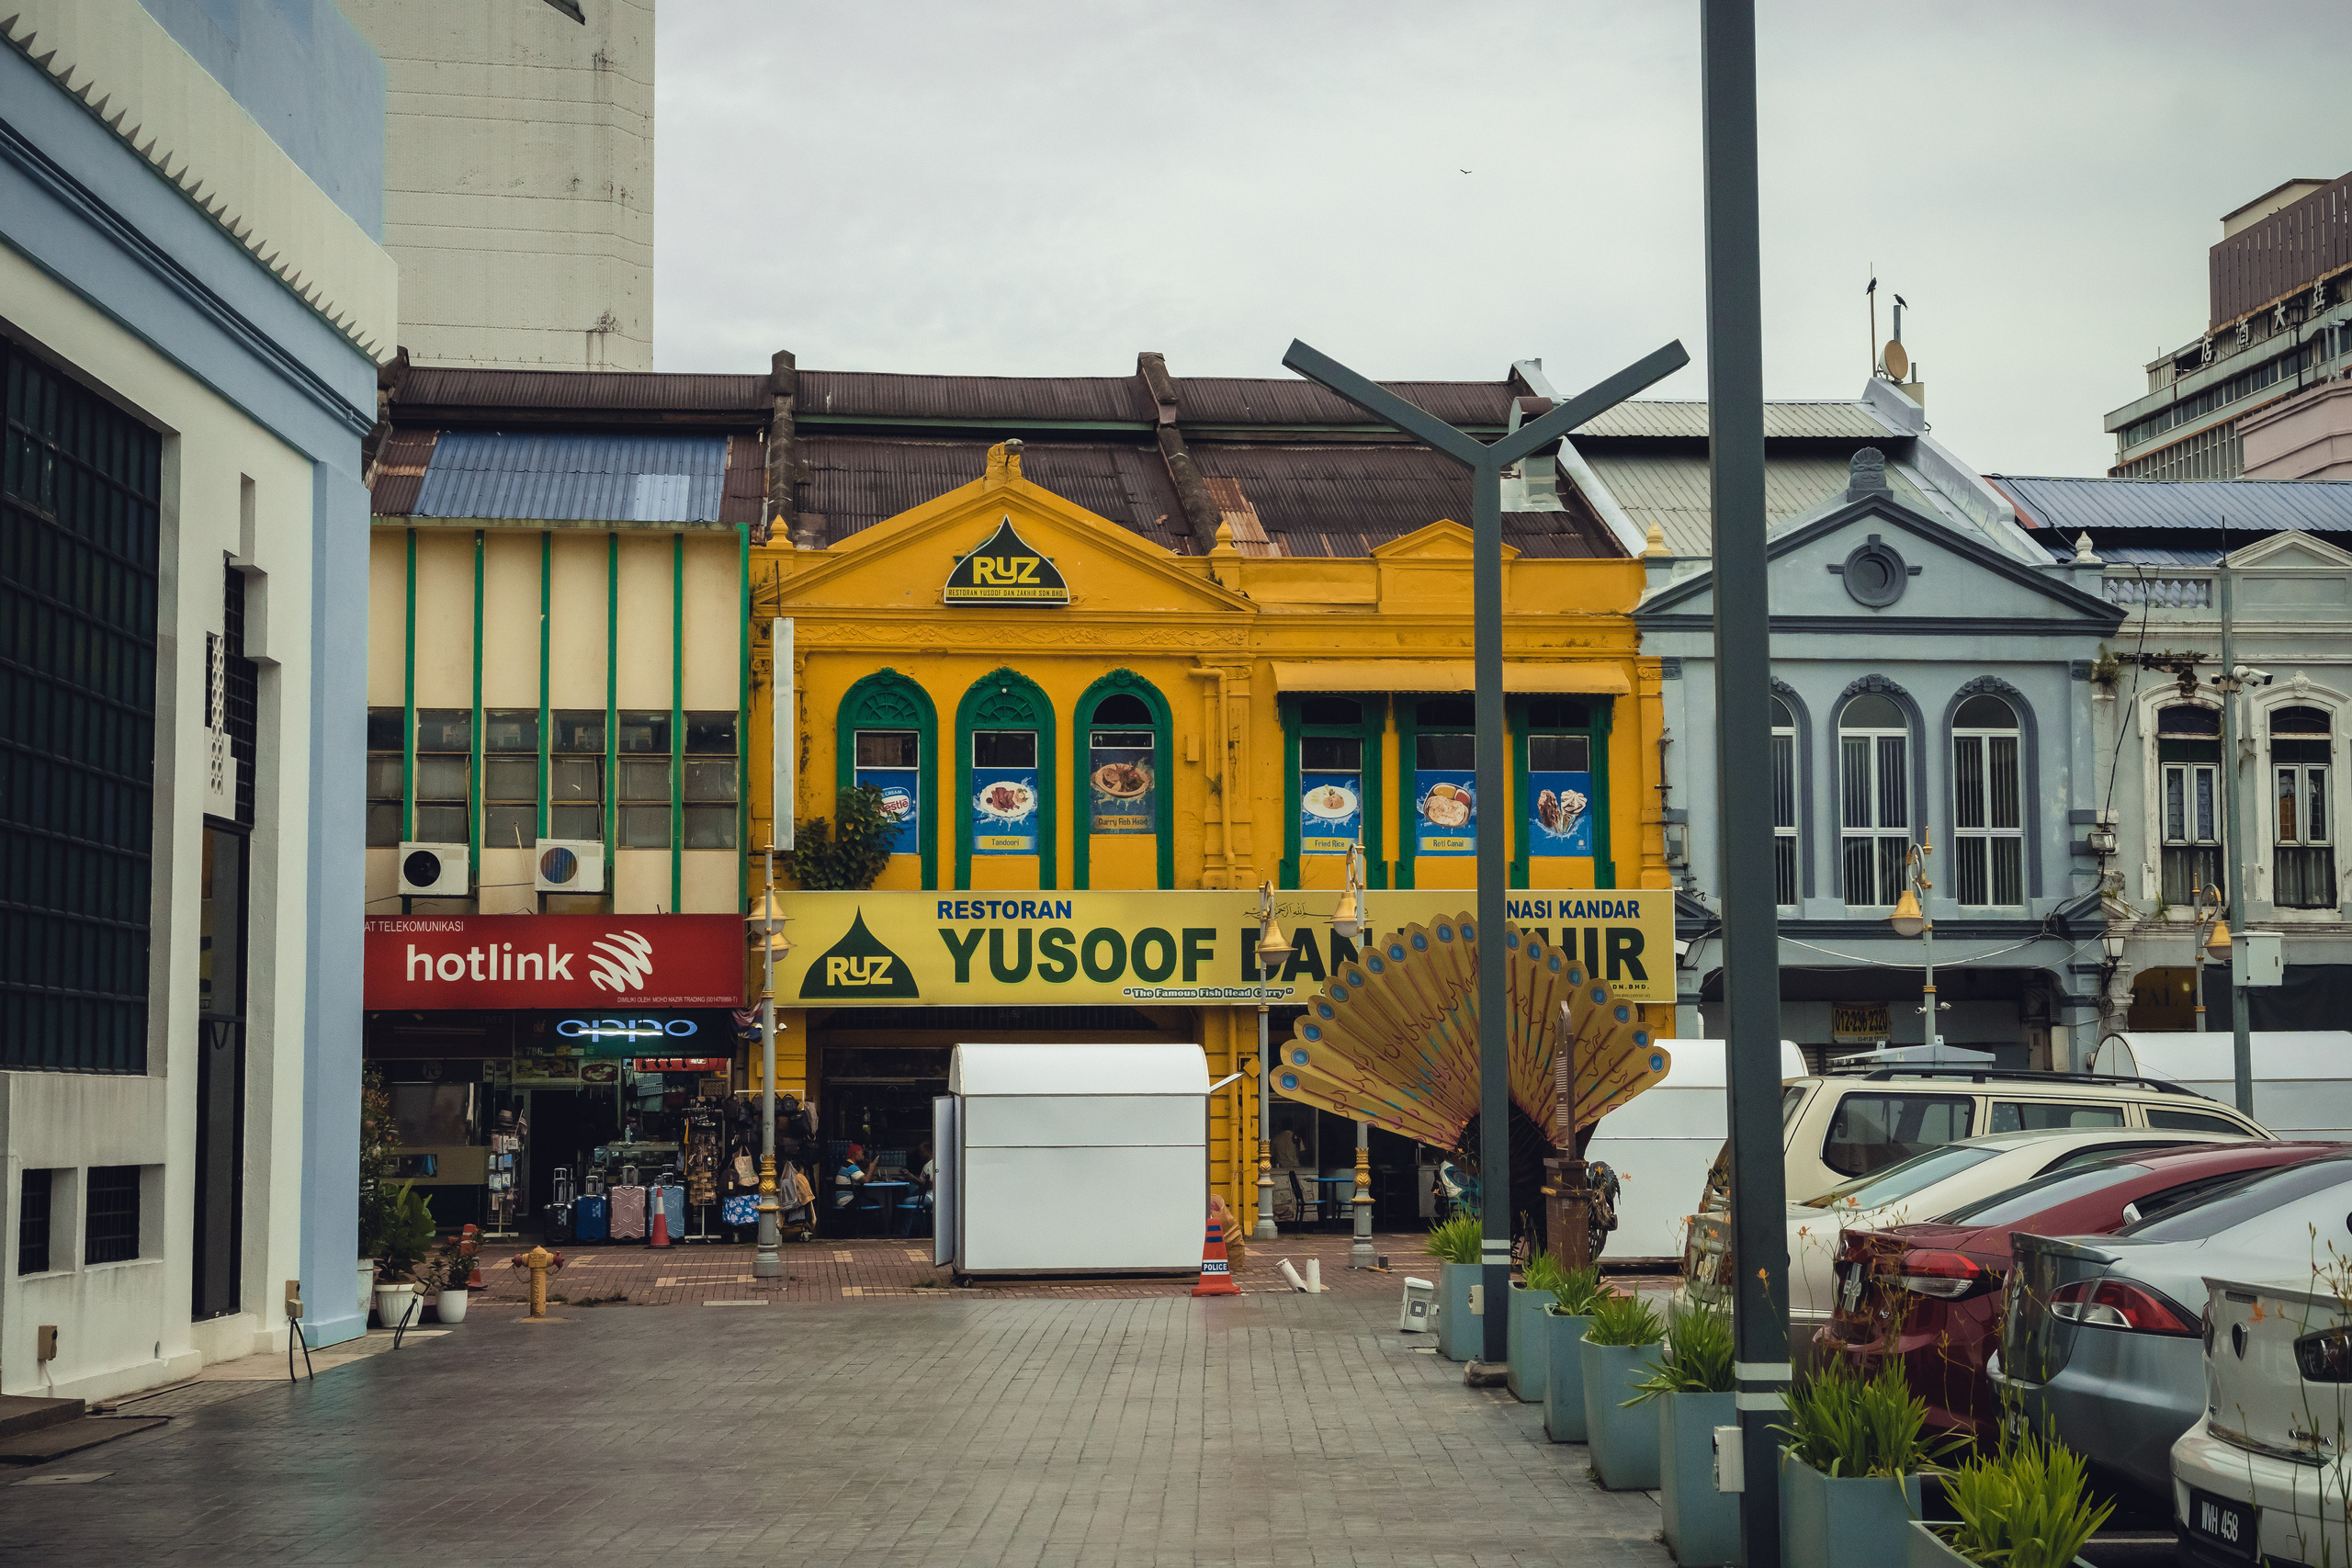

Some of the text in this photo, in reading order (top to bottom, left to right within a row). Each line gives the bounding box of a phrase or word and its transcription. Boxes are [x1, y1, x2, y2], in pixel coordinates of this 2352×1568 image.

[1098, 818, 1148, 827] Curry Fish Head
[991, 838, 1020, 846] Tandoori
[937, 900, 1072, 919] RESTORAN
[1506, 899, 1641, 919] NASI KANDAR
[379, 920, 464, 932] TELEKOMUNIKASI
[406, 942, 574, 982] hotlink
[937, 927, 1217, 984] YUSOOF
[1133, 988, 1284, 999] The Famous Fish Head Crry
[1204, 1263, 1227, 1271] POLICE
[2221, 1509, 2239, 1542] 458
